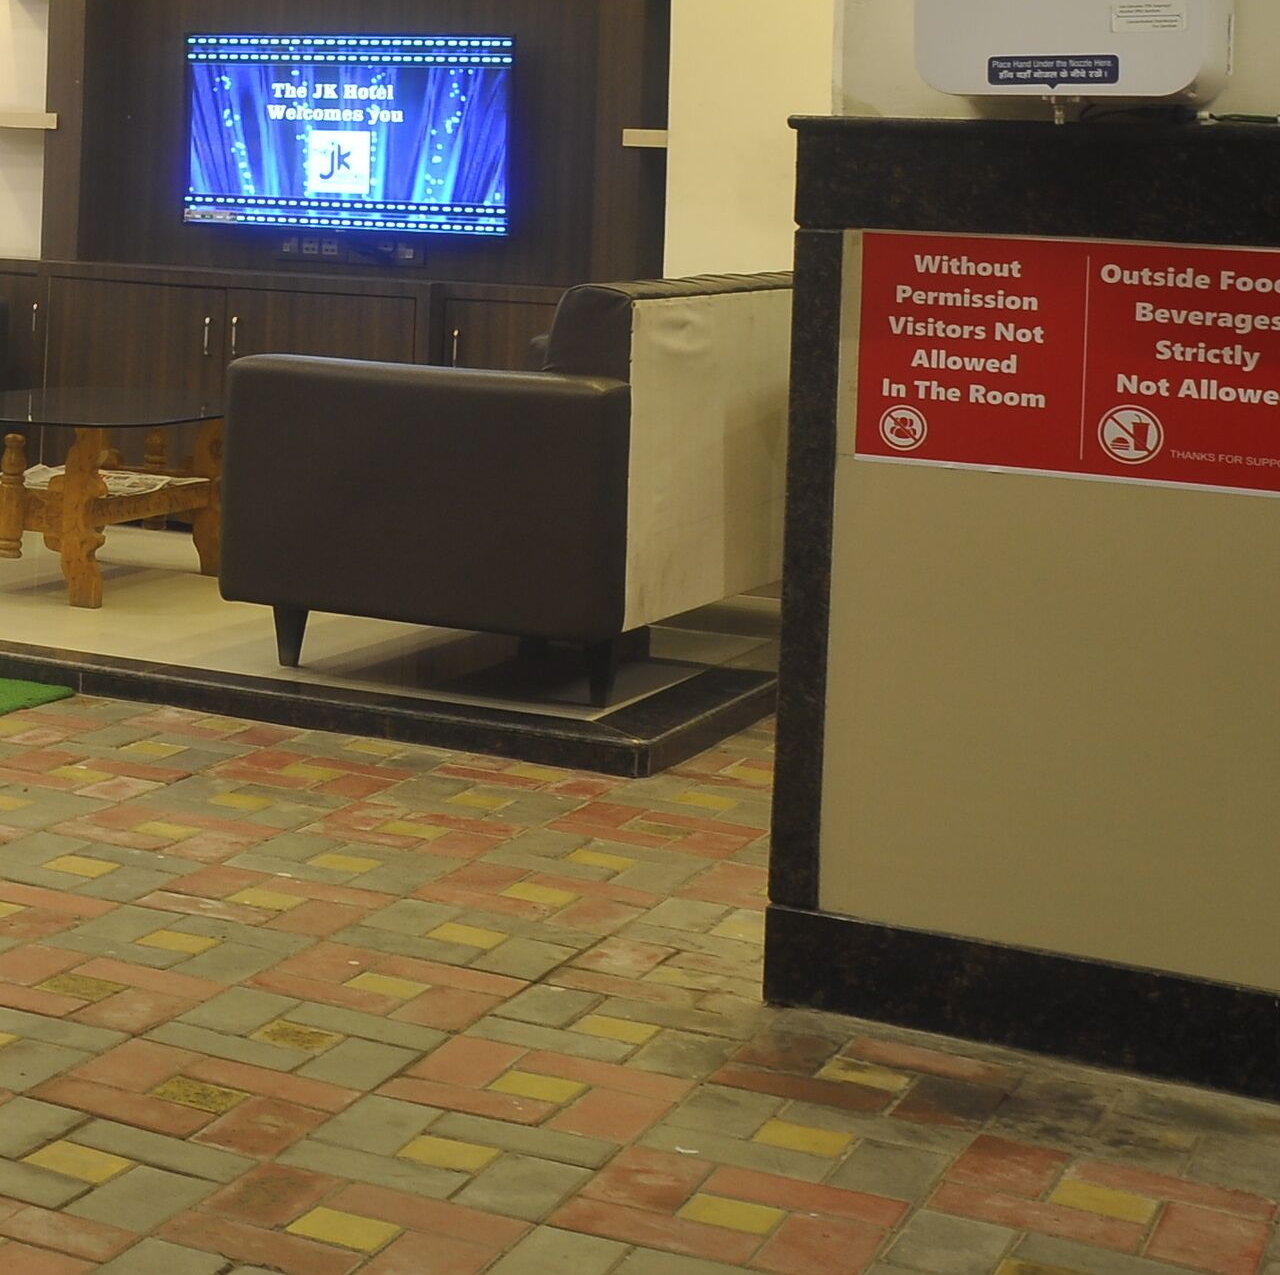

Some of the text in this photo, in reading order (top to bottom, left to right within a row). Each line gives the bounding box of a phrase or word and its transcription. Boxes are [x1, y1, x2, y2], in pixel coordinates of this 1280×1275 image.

[271, 82, 394, 100] The JK Hotel
[266, 104, 404, 125] Welcomes you
[914, 254, 1021, 279] Without
[1100, 264, 1210, 290] Outside
[896, 285, 1038, 311] Permission
[889, 316, 1044, 344] Visitors Not
[1135, 302, 1280, 334] Beverages
[911, 349, 1017, 374] Allowed
[1155, 340, 1260, 372] Strictly
[882, 378, 1046, 408] In The Room
[1117, 374, 1170, 397] Not
[1170, 449, 1216, 463] THANKS
[1218, 454, 1243, 465] FOR
